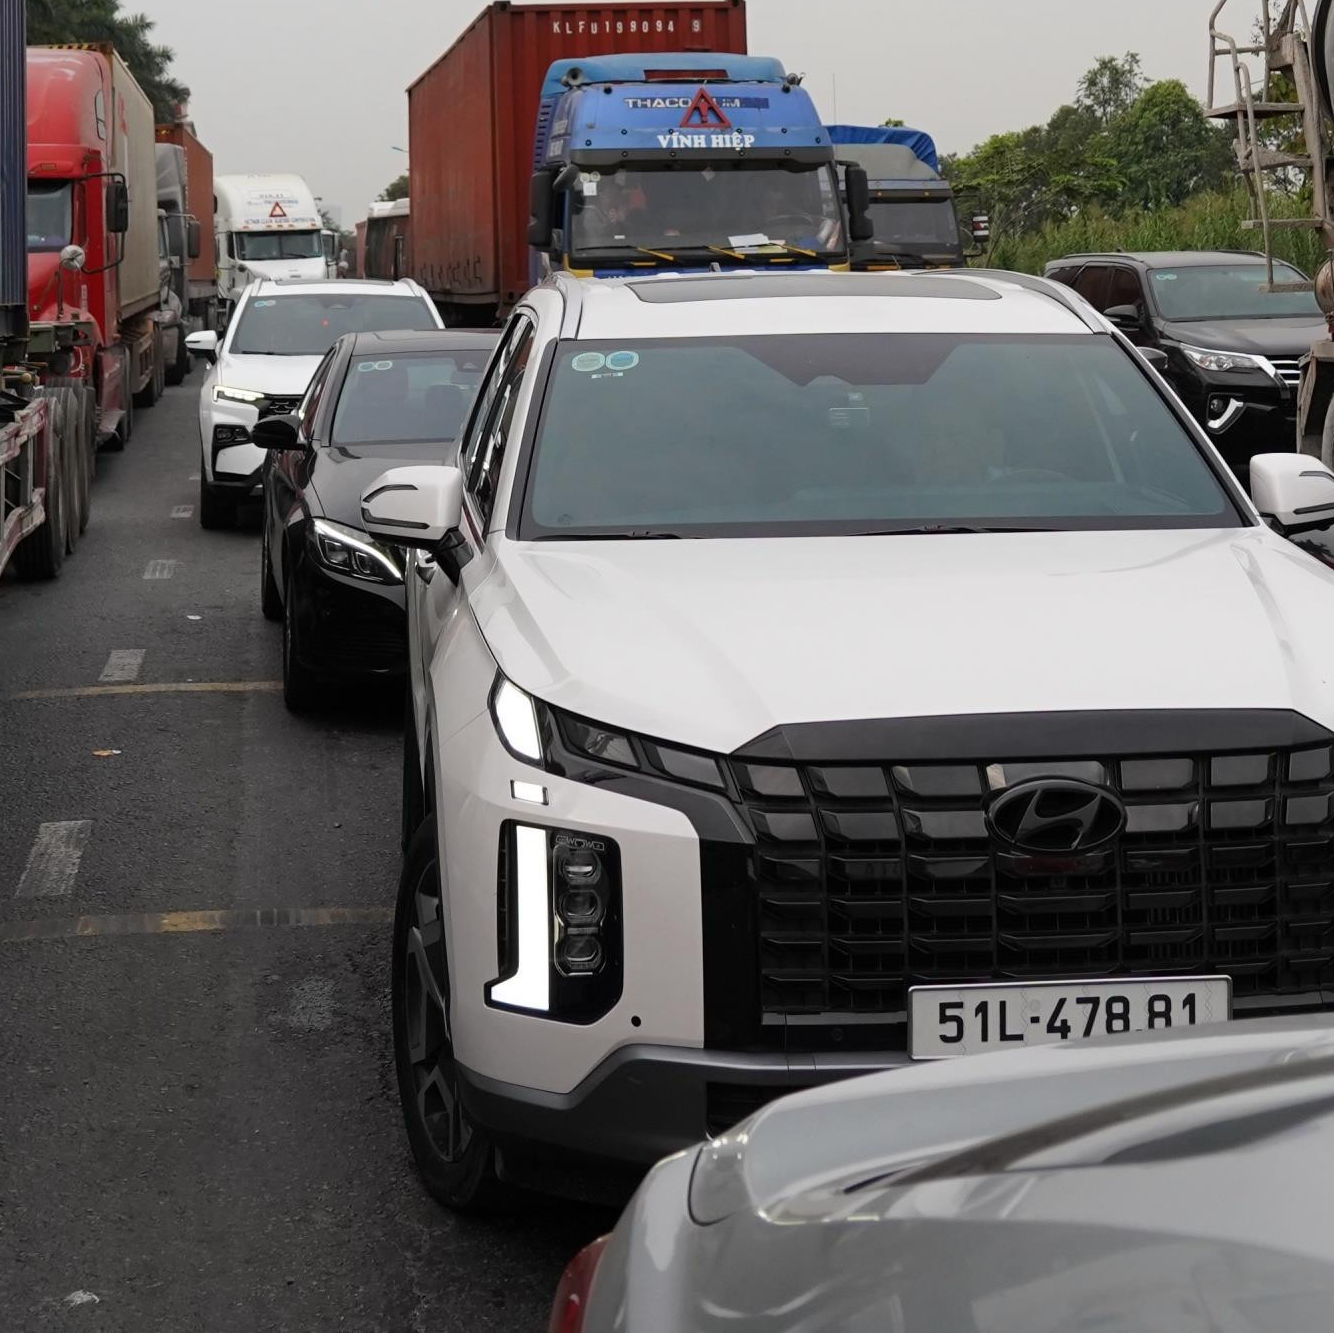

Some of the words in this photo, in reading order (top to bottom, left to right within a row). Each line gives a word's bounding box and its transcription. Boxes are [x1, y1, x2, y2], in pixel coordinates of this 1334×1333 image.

[624, 97, 692, 108] THACO
[710, 131, 755, 151] HIỆP
[938, 992, 1197, 1045] 51L-47881
